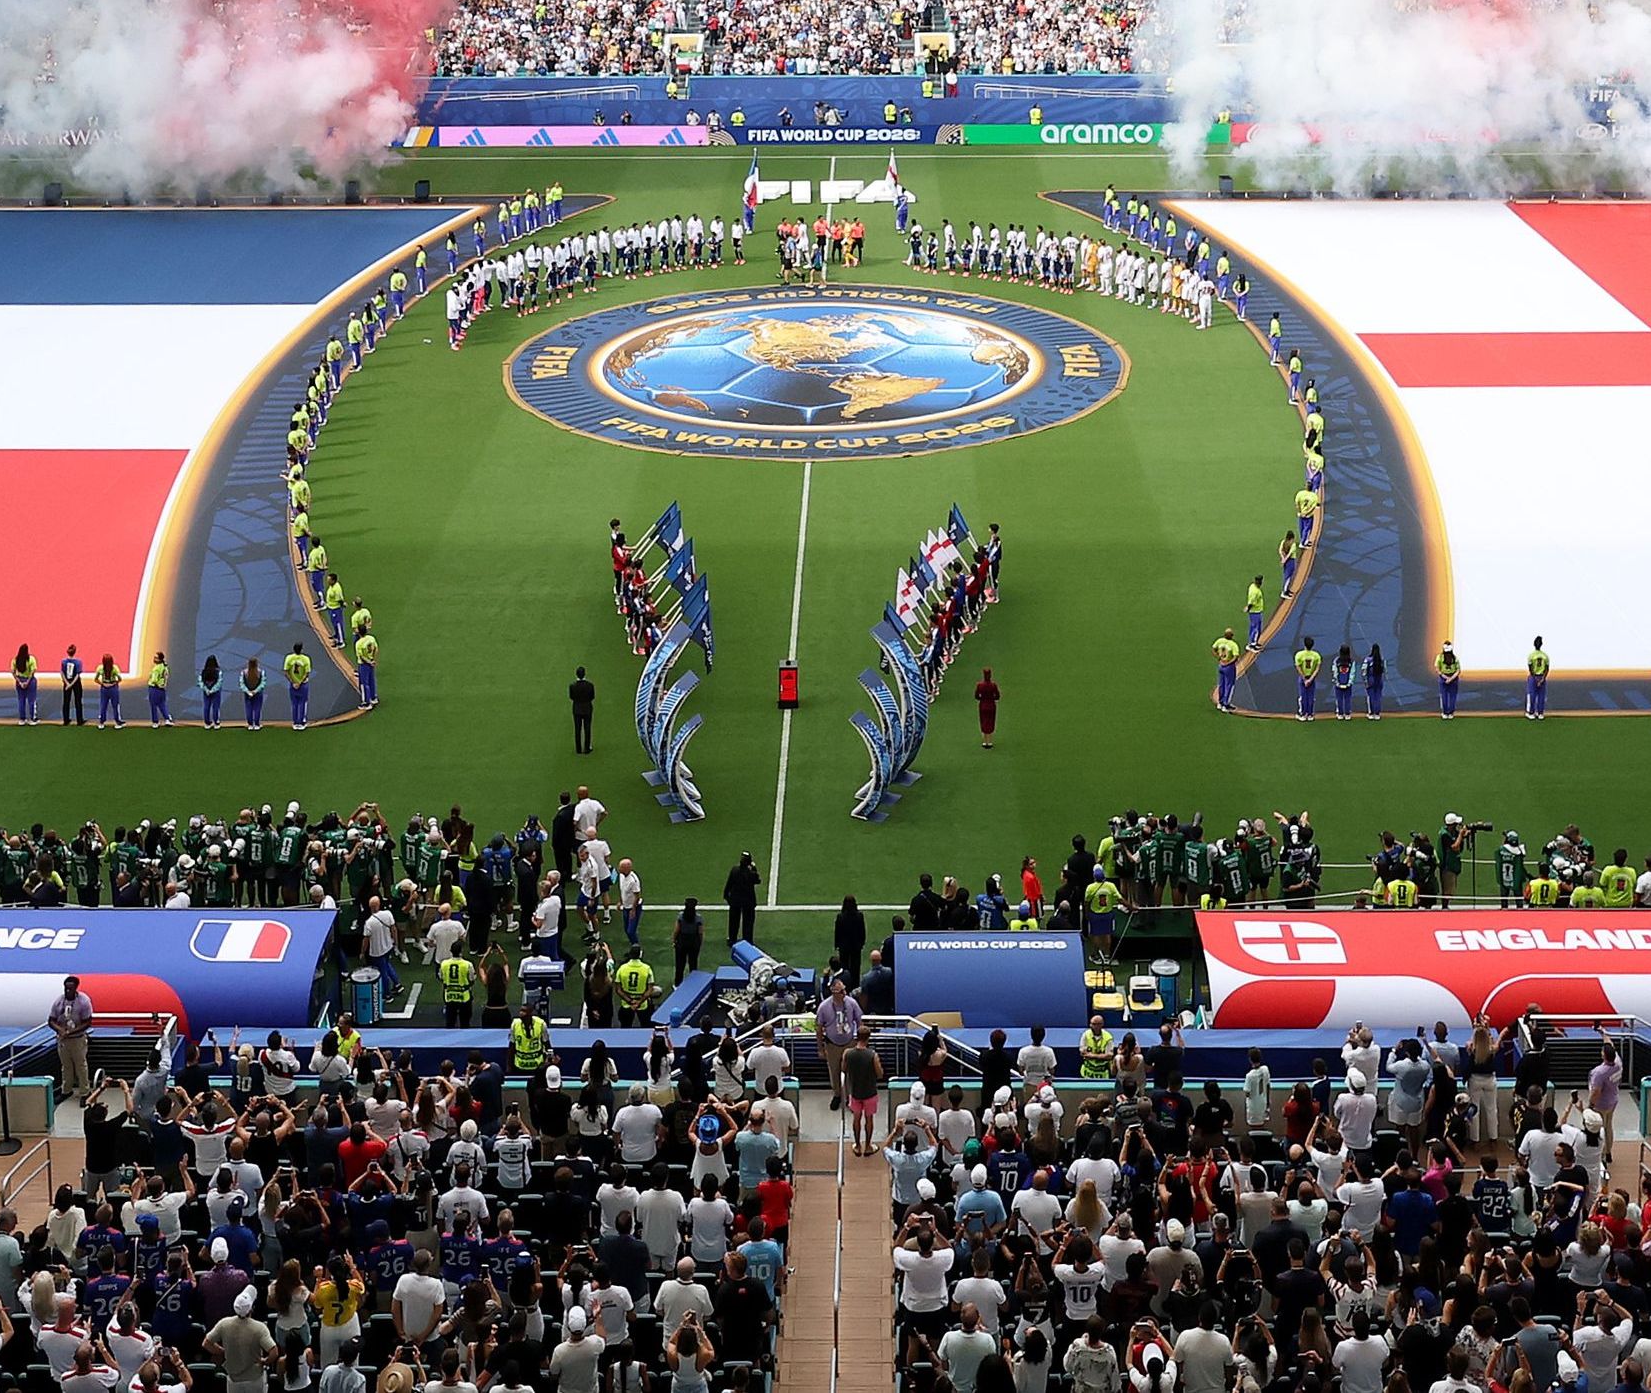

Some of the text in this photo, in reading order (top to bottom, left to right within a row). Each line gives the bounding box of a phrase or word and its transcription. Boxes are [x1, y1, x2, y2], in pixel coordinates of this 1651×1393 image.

[1590, 90, 1620, 102] FIFA
[748, 129, 916, 142] FIFA WORLD CUP 2026
[1040, 123, 1153, 145] aramco
[744, 180, 917, 204] FIFA
[646, 290, 998, 314] FIFA WORLD CUP 2026
[532, 346, 579, 380] FIFA
[1059, 343, 1101, 377] FIFA
[600, 416, 1016, 449] FIFA WORLD CUP 2026
[908, 940, 1068, 950] FIFA WORLD CUP 2026
[236, 1075, 252, 1093] 10
[1000, 1170, 1017, 1190] 10
[1482, 1196, 1504, 1218] 22
[377, 1257, 404, 1278] 26
[444, 1249, 472, 1267] 26
[749, 1263, 771, 1281] 10
[1069, 1286, 1091, 1303] 10
[94, 1297, 117, 1316] 26
[333, 1303, 344, 1324] 7
